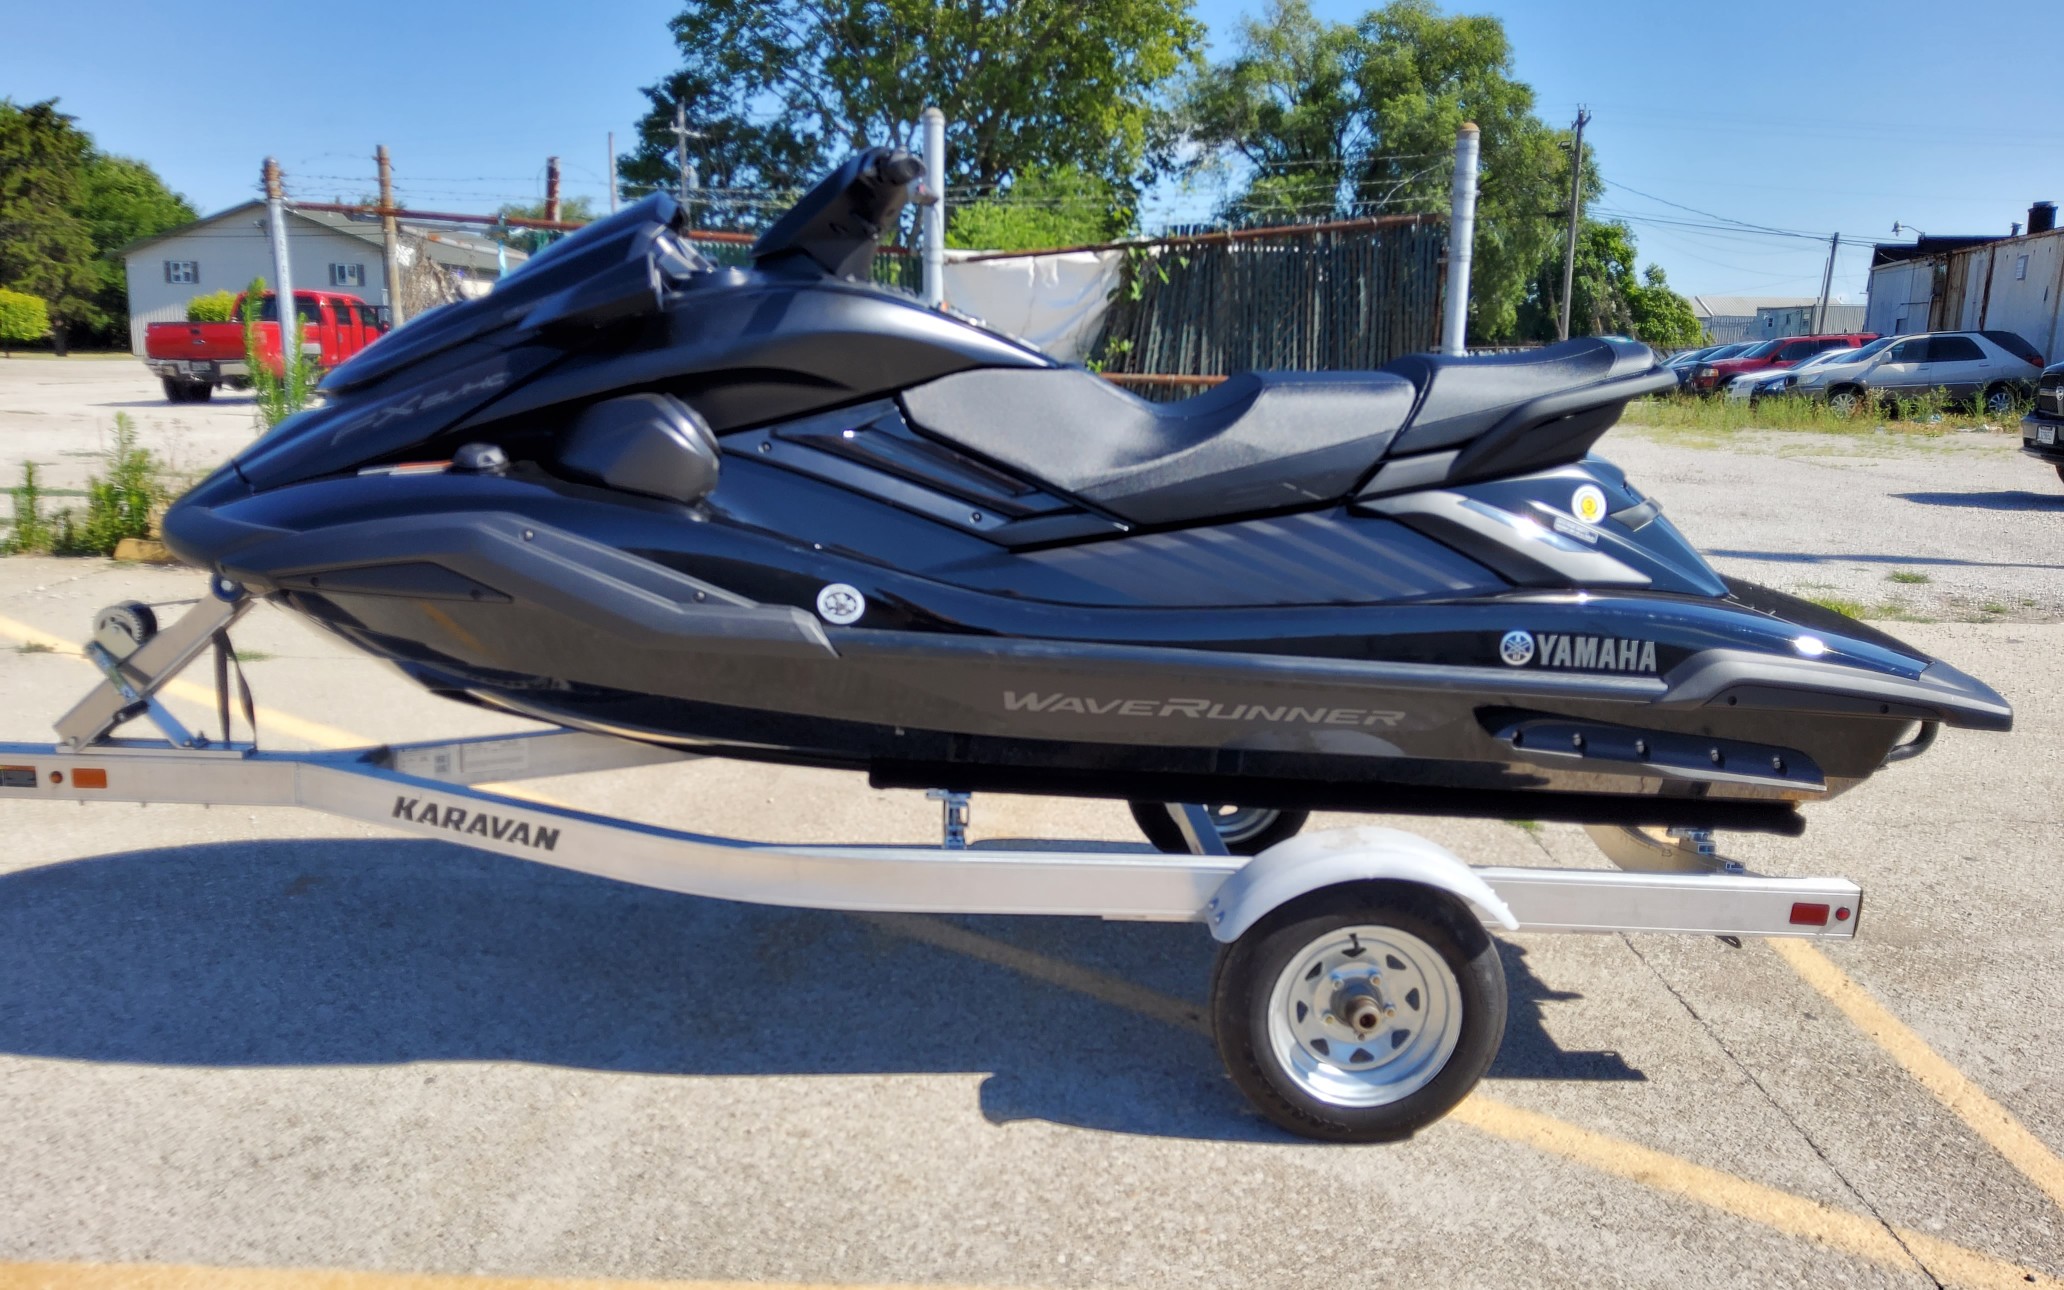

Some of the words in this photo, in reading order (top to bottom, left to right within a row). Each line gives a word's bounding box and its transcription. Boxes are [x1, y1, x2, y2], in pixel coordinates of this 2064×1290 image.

[1536, 633, 1658, 673] YAMAHA
[1002, 690, 1407, 727] WAVERUNNER
[391, 795, 562, 852] KARAVAN
